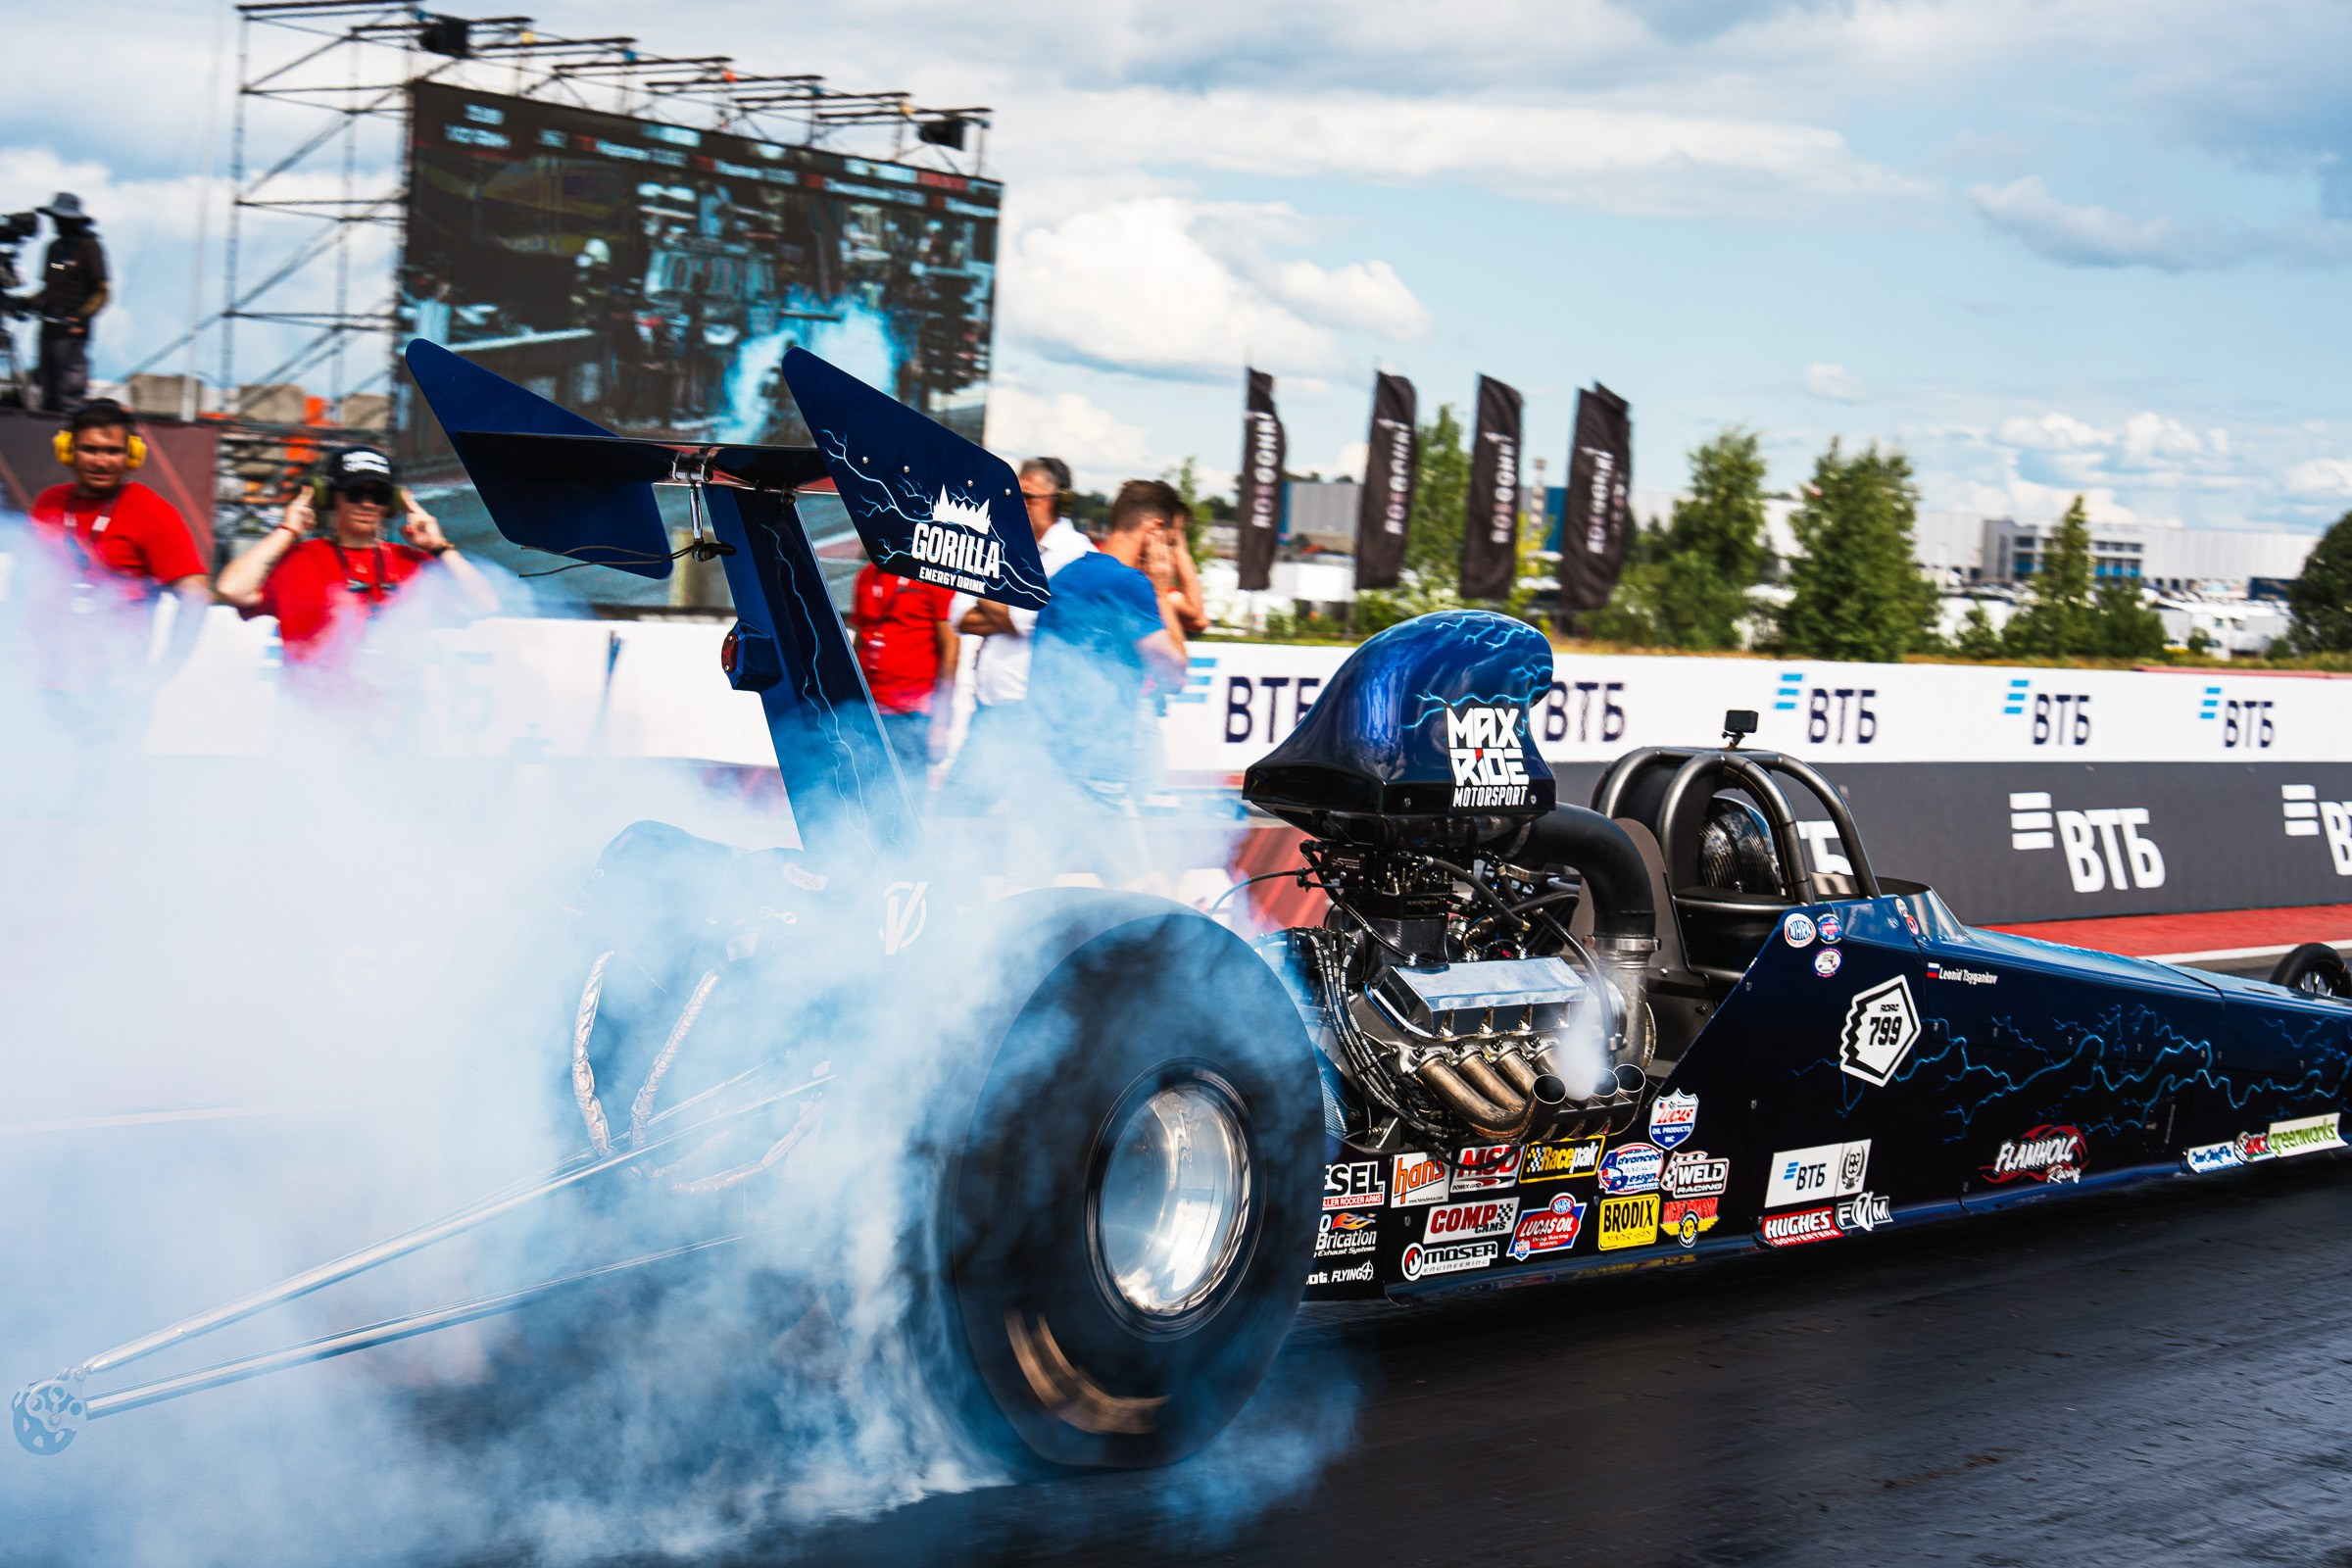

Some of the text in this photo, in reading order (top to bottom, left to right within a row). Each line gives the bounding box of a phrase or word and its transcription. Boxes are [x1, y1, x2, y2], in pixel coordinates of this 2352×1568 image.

[911, 522, 1000, 579] GORILLA
[919, 565, 986, 595] ENERGY DRINK
[1544, 681, 1626, 742] ВТБ
[1808, 688, 1877, 745] ВТБ
[2033, 693, 2090, 746] ВТБ
[2224, 700, 2275, 748] ВТБ
[1446, 707, 1522, 749] MAX
[1452, 786, 1528, 808] MOTORSPORT
[2056, 808, 2166, 894] ВТБ
[1869, 1015, 1903, 1046] 799
[1656, 1108, 1693, 1124] LUCAS
[1662, 1125, 1691, 1134] PRODUCTS
[1457, 1146, 1522, 1178] MSD
[1541, 1142, 1598, 1174] Racepak
[1677, 1183, 1723, 1194] RACING
[1679, 1163, 1725, 1186] WELD
[1796, 1163, 1827, 1191] ВТБ
[1340, 1197, 1364, 1206] ROCKER
[1365, 1195, 1382, 1203] ARMS
[1430, 1204, 1497, 1234] COMP
[1475, 1221, 1506, 1234] CAMS
[1519, 1217, 1574, 1238] LUCAS OIL
[1603, 1200, 1655, 1233] BRODIX
[1765, 1210, 1832, 1239] HUGHES
[1424, 1243, 1496, 1265] MOSER
